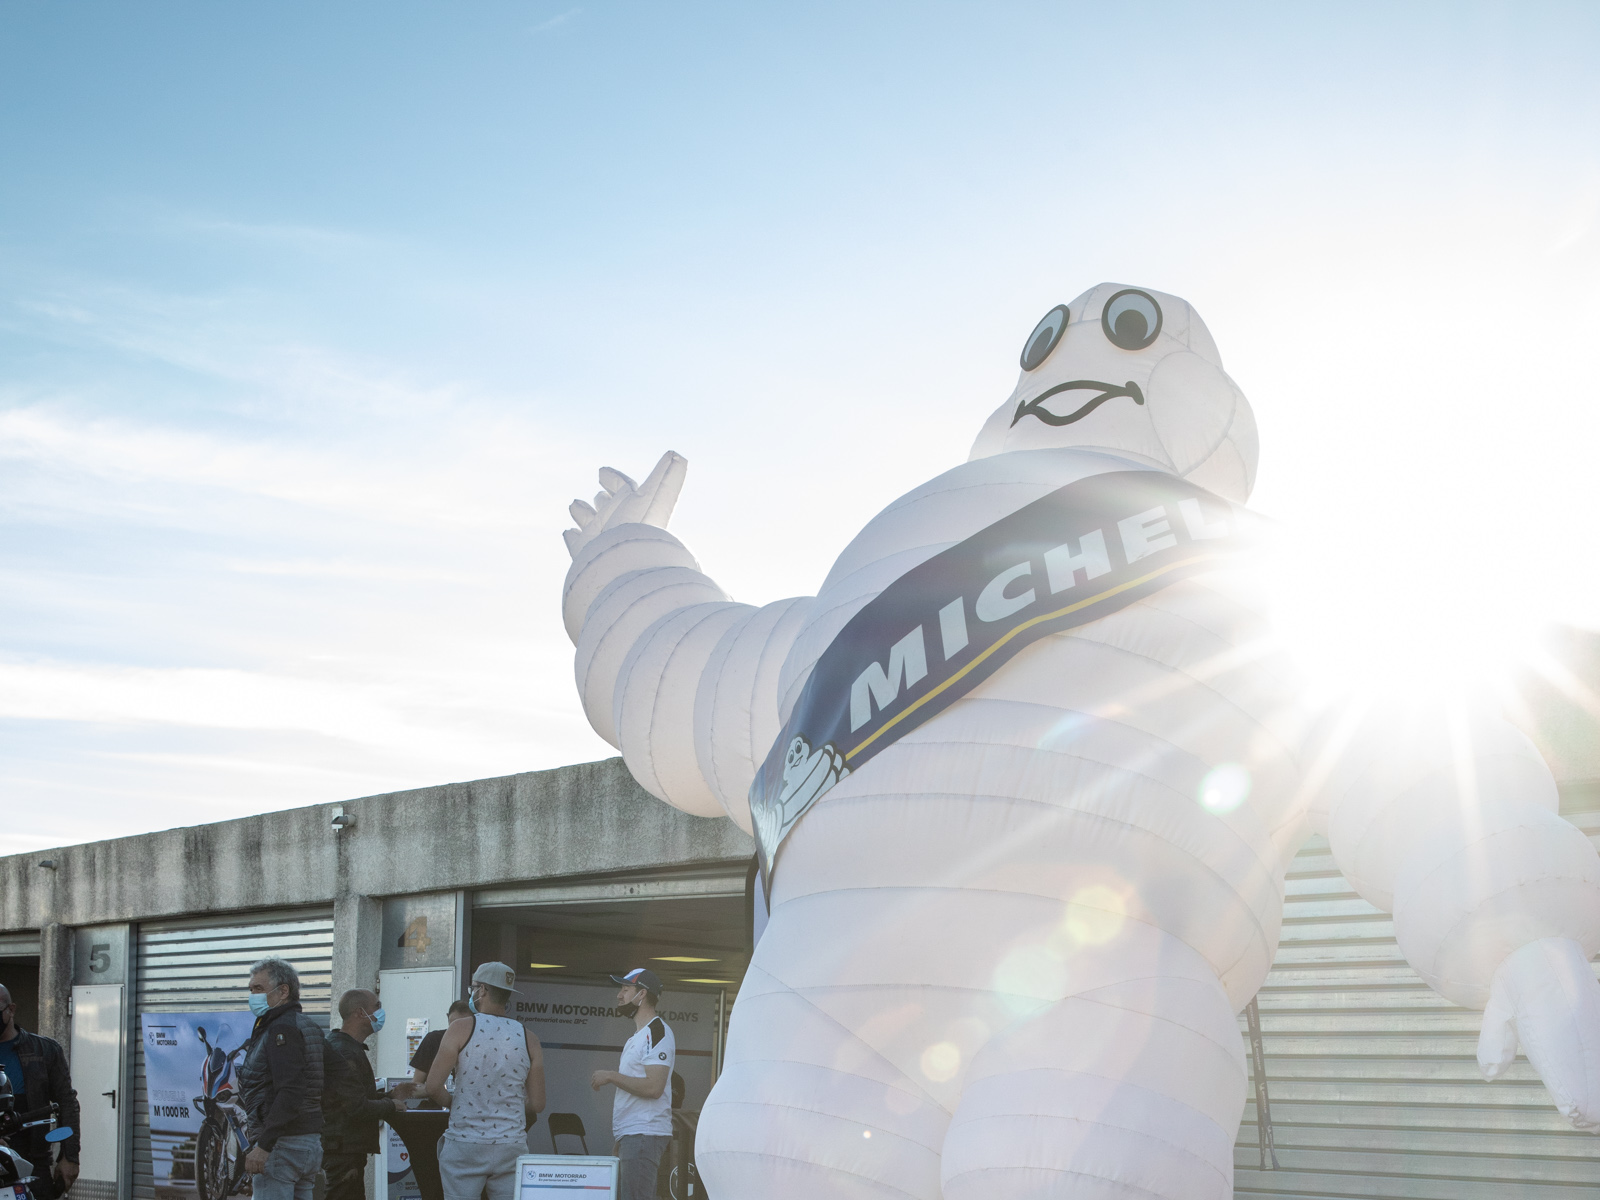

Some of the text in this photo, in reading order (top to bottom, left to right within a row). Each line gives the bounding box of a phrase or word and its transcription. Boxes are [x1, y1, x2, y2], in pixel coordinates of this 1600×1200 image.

[849, 497, 1230, 734] MICHEL
[397, 916, 432, 953] 4
[89, 943, 111, 974] 5
[516, 1001, 549, 1015] BMW
[551, 1004, 623, 1019] MOTORRAD
[669, 1010, 699, 1023] DAYS
[153, 1105, 190, 1119] M 1000 RR
[16, 1193, 27, 1200] 30
